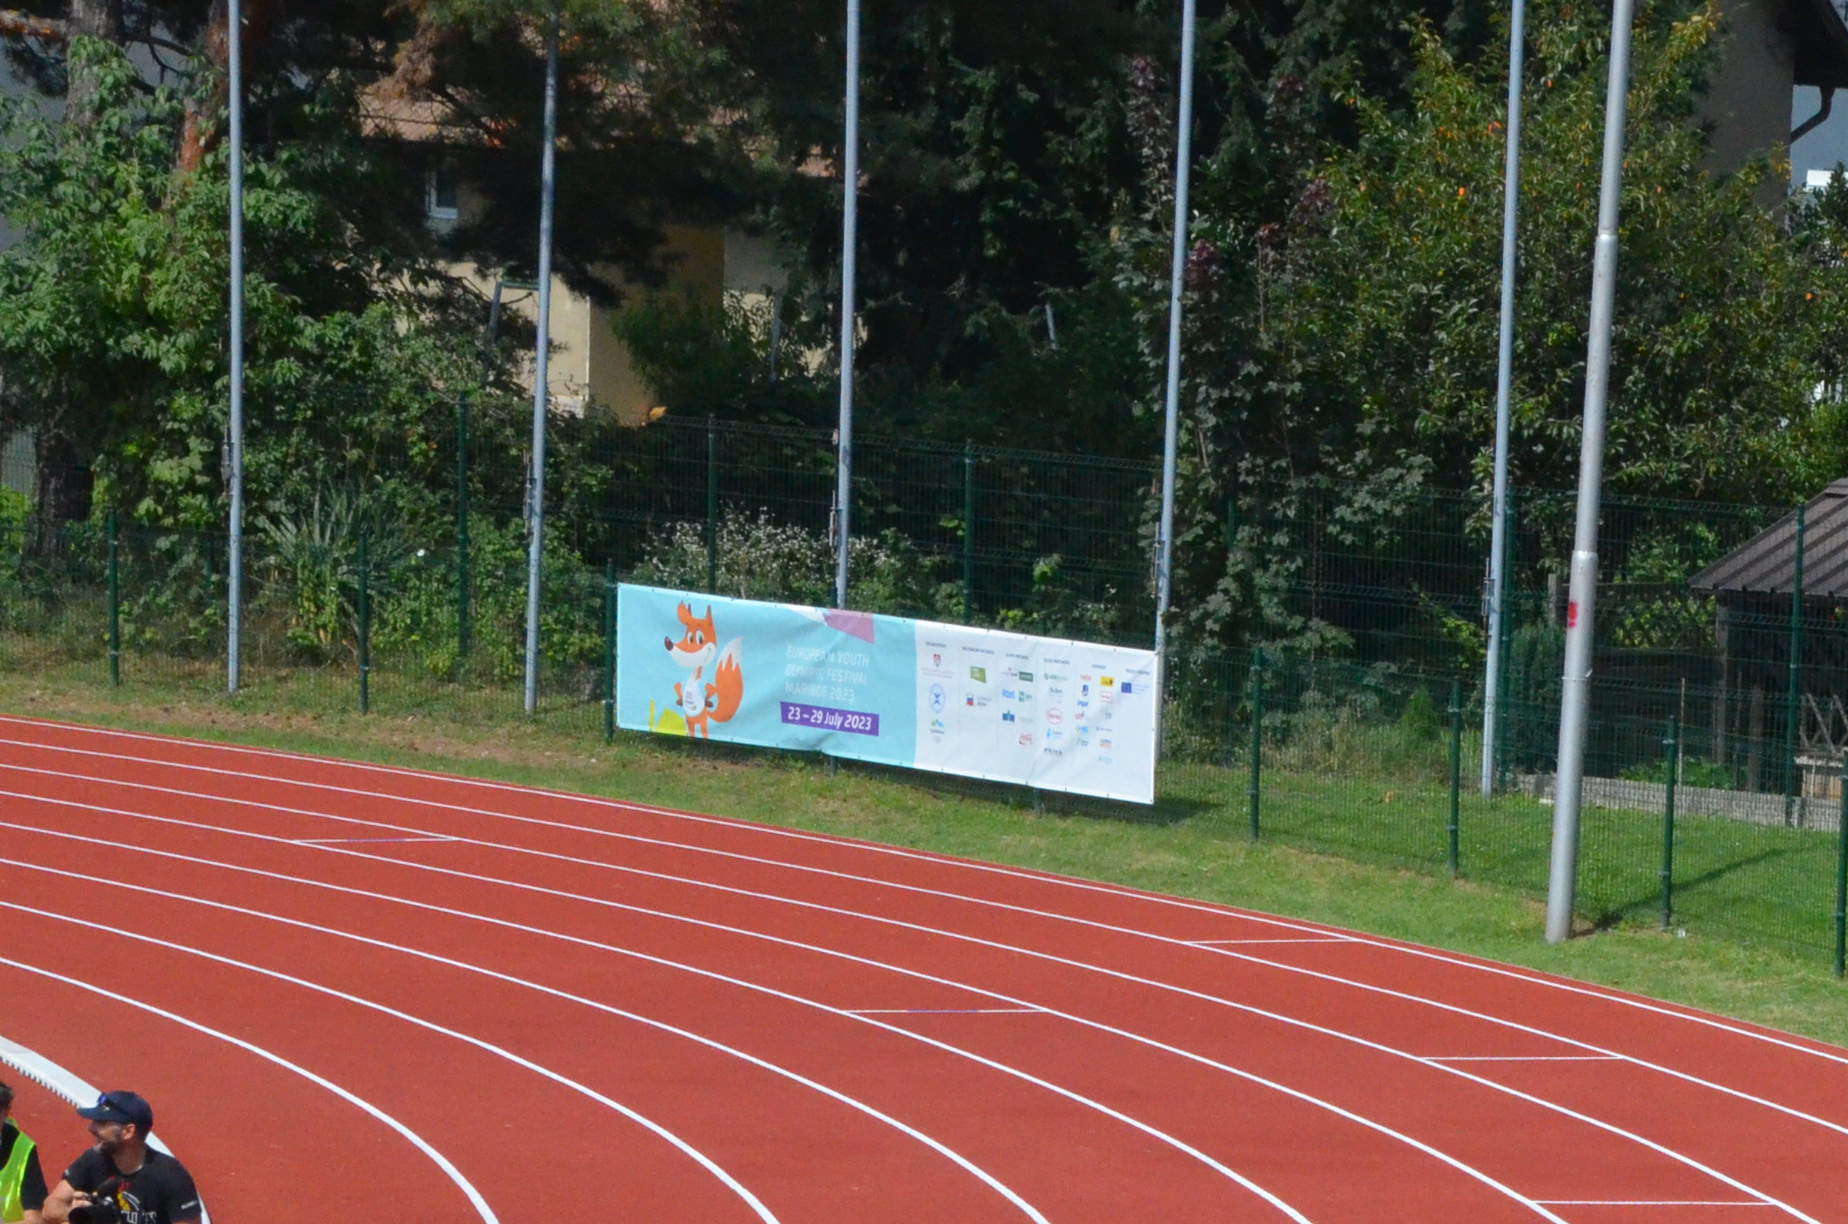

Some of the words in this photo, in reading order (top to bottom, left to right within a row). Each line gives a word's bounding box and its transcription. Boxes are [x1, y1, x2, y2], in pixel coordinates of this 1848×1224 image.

[838, 651, 870, 667] YOUTH
[787, 706, 801, 721] 23
[810, 709, 823, 724] 29
[824, 712, 843, 730] July
[844, 714, 872, 731] 2023
